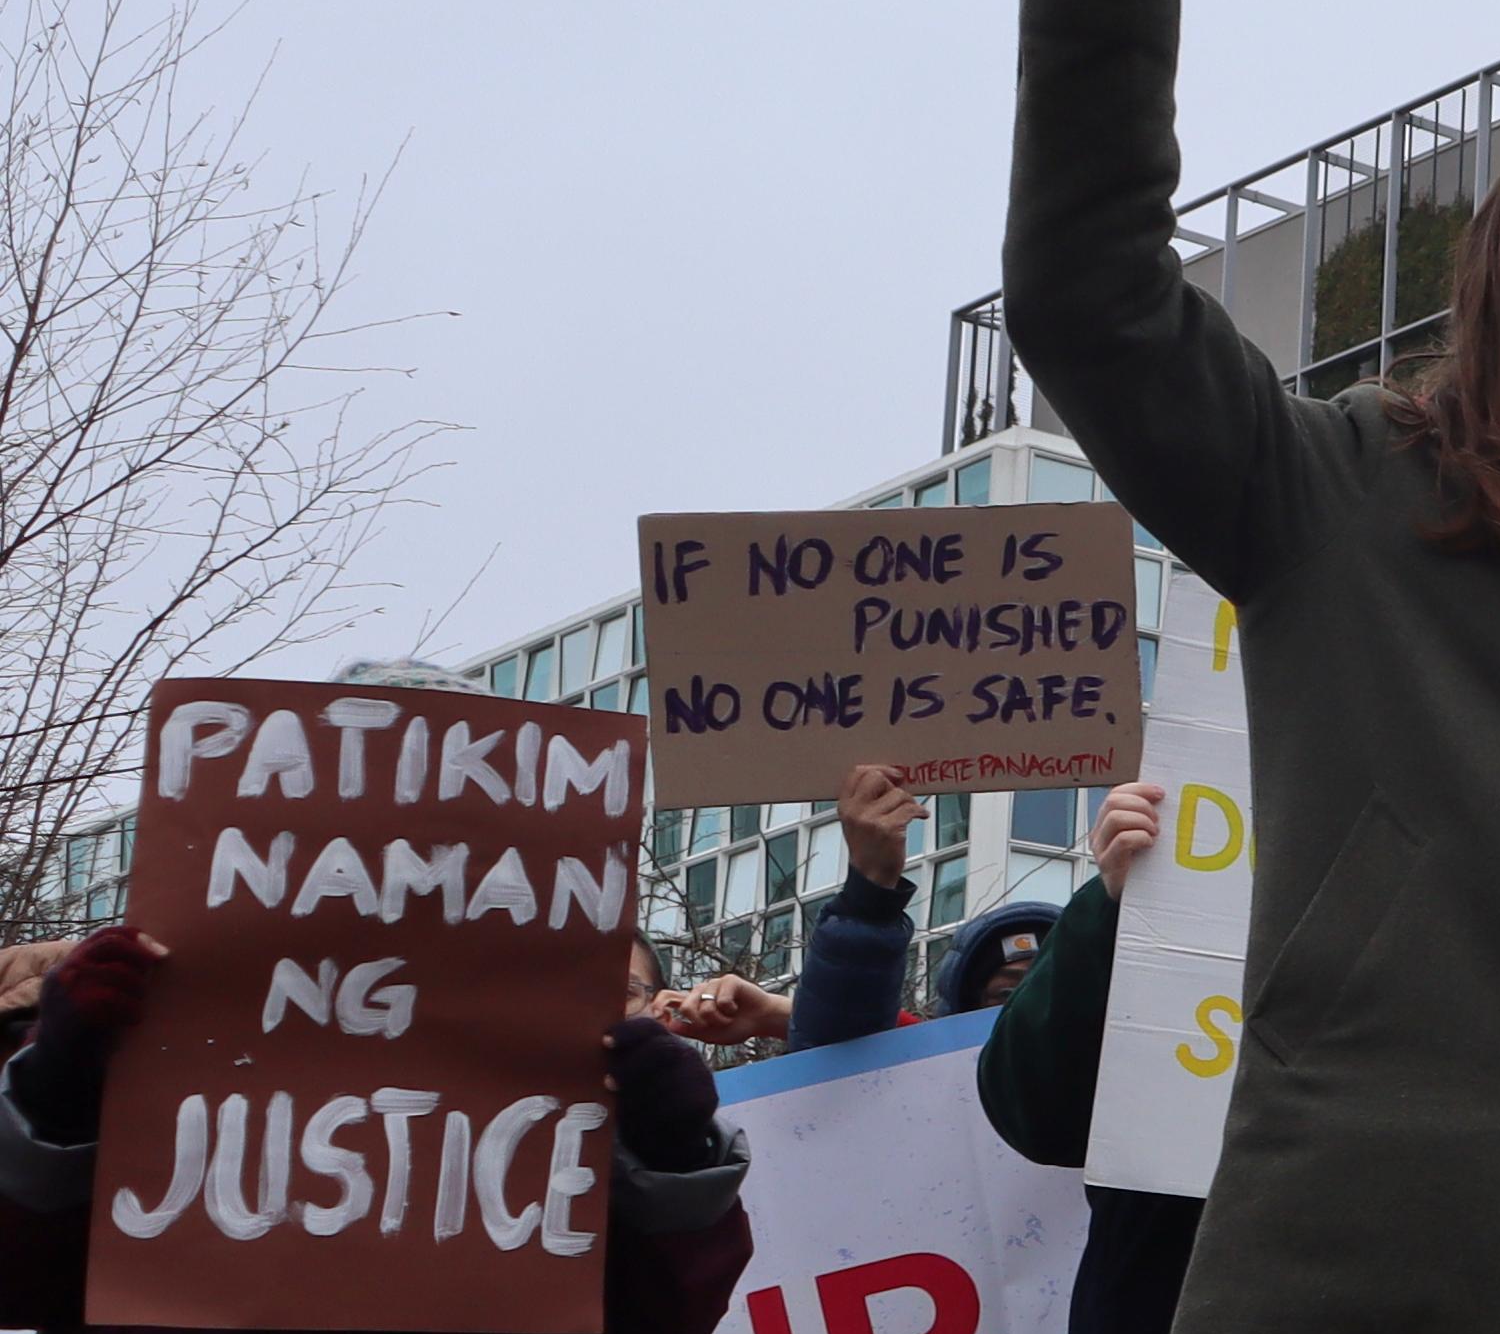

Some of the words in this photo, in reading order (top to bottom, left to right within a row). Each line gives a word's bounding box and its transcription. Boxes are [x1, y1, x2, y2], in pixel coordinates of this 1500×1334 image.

[655, 541, 710, 604] IF
[749, 534, 833, 596] NO
[854, 533, 964, 586] ONE
[1001, 533, 1064, 582] IS
[854, 597, 1128, 654] PUNISHED
[666, 674, 740, 734] NO
[763, 672, 864, 729] ONE
[890, 673, 944, 725] IS
[967, 674, 1116, 725] SAFE.
[157, 697, 630, 816] PATIKIM
[978, 747, 1115, 780] PANAGUTIN
[206, 826, 627, 932] NAMAN
[261, 956, 418, 1039] NG
[111, 1087, 609, 1257] JUSTICE
